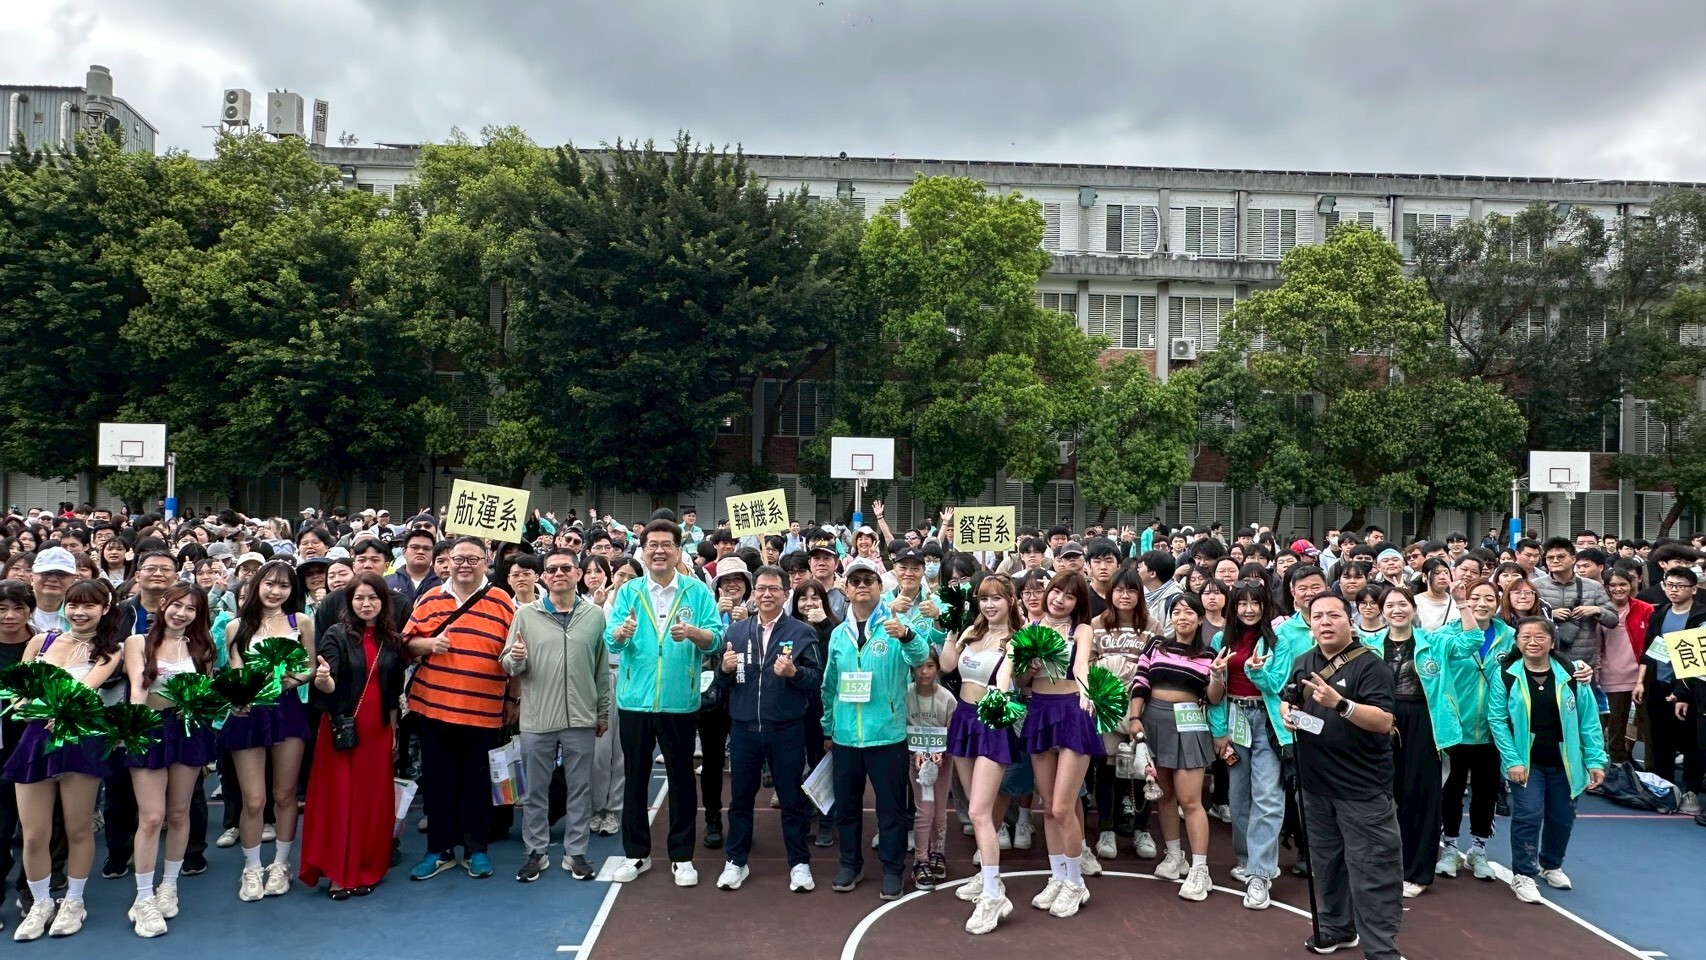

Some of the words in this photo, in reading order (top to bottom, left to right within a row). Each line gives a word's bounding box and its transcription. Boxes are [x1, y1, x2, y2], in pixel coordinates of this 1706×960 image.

[454, 490, 517, 531] 航運系
[733, 498, 784, 530] 輪機系
[959, 515, 1010, 544] 餐管系
